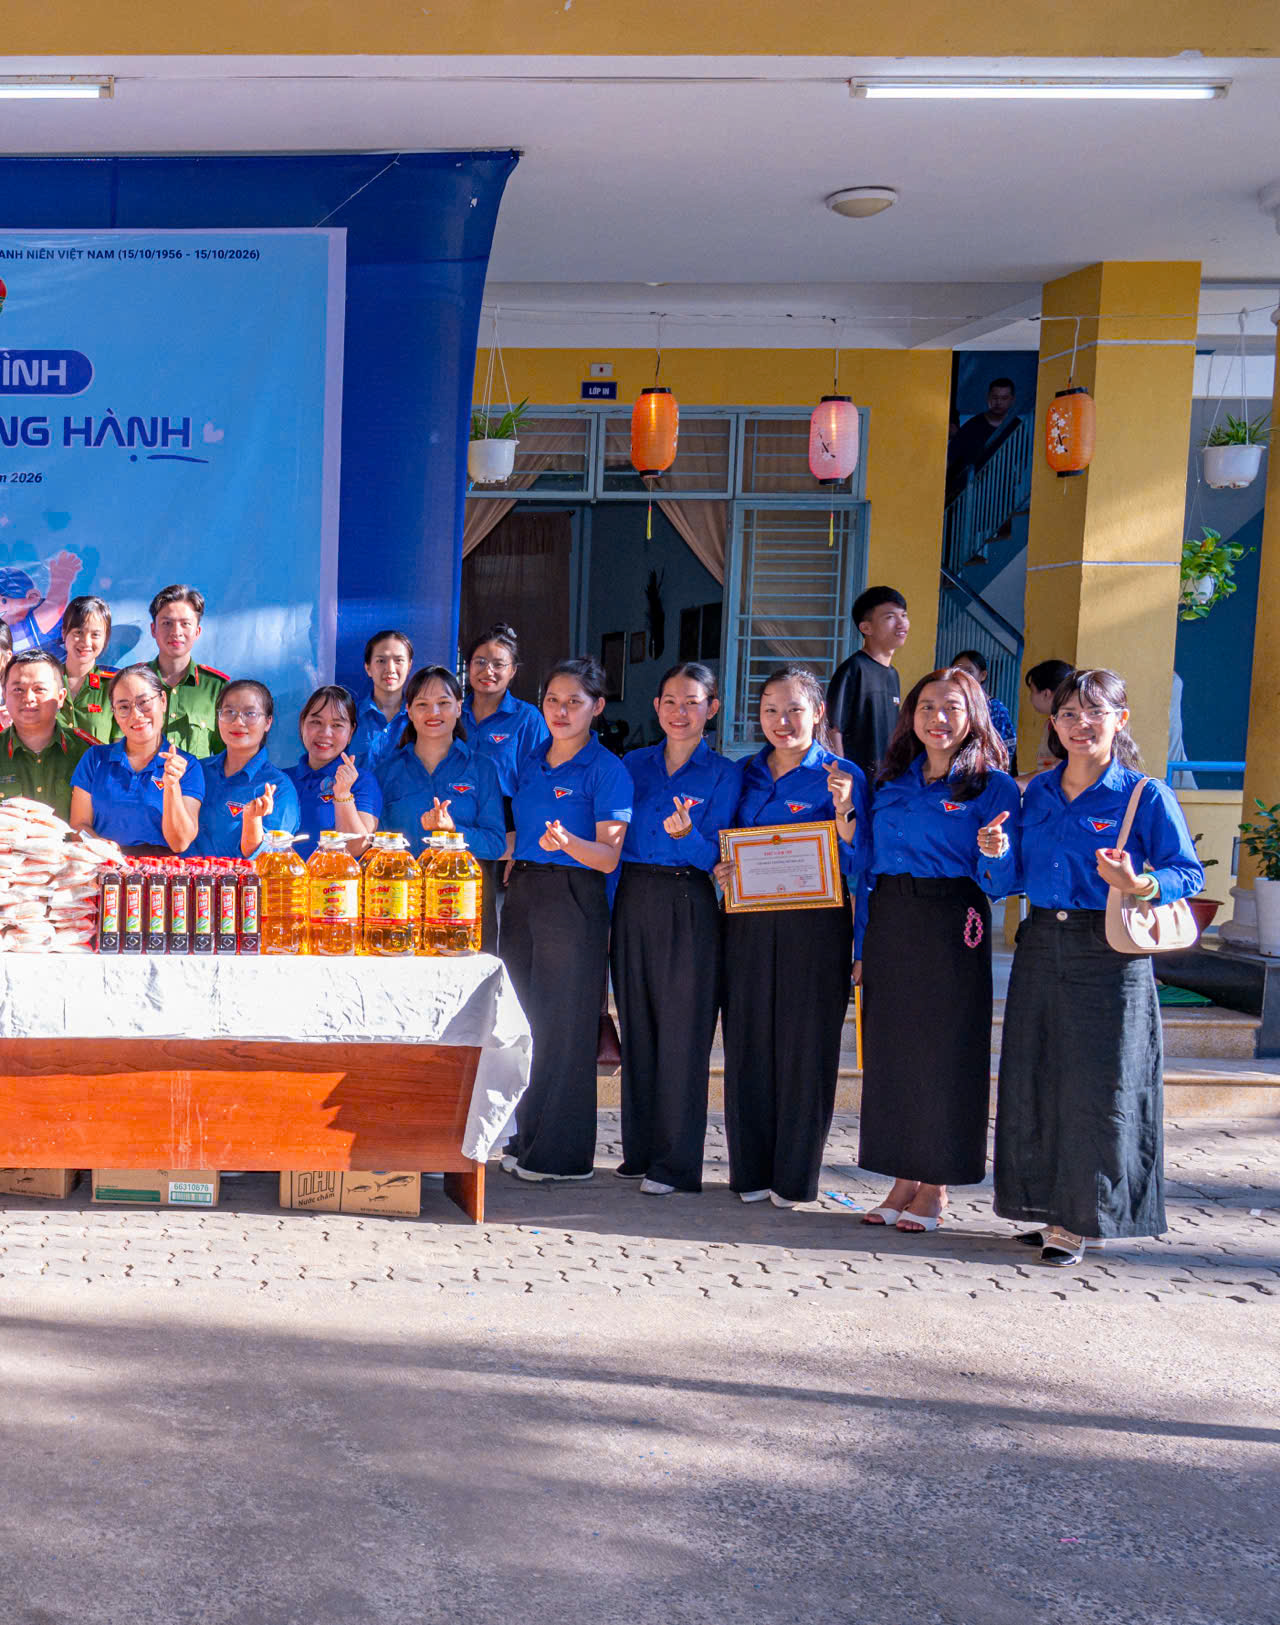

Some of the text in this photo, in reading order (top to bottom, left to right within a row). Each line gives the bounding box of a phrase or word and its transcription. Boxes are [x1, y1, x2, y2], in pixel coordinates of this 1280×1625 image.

[26, 247, 54, 260] NIÊN
[58, 247, 84, 260] VIỆT
[88, 249, 114, 260] NAM
[118, 249, 182, 261] (15/10/1956
[194, 249, 260, 261] 15/10/2026)
[63, 407, 191, 448] HÀNH
[10, 472, 43, 484] 2026
